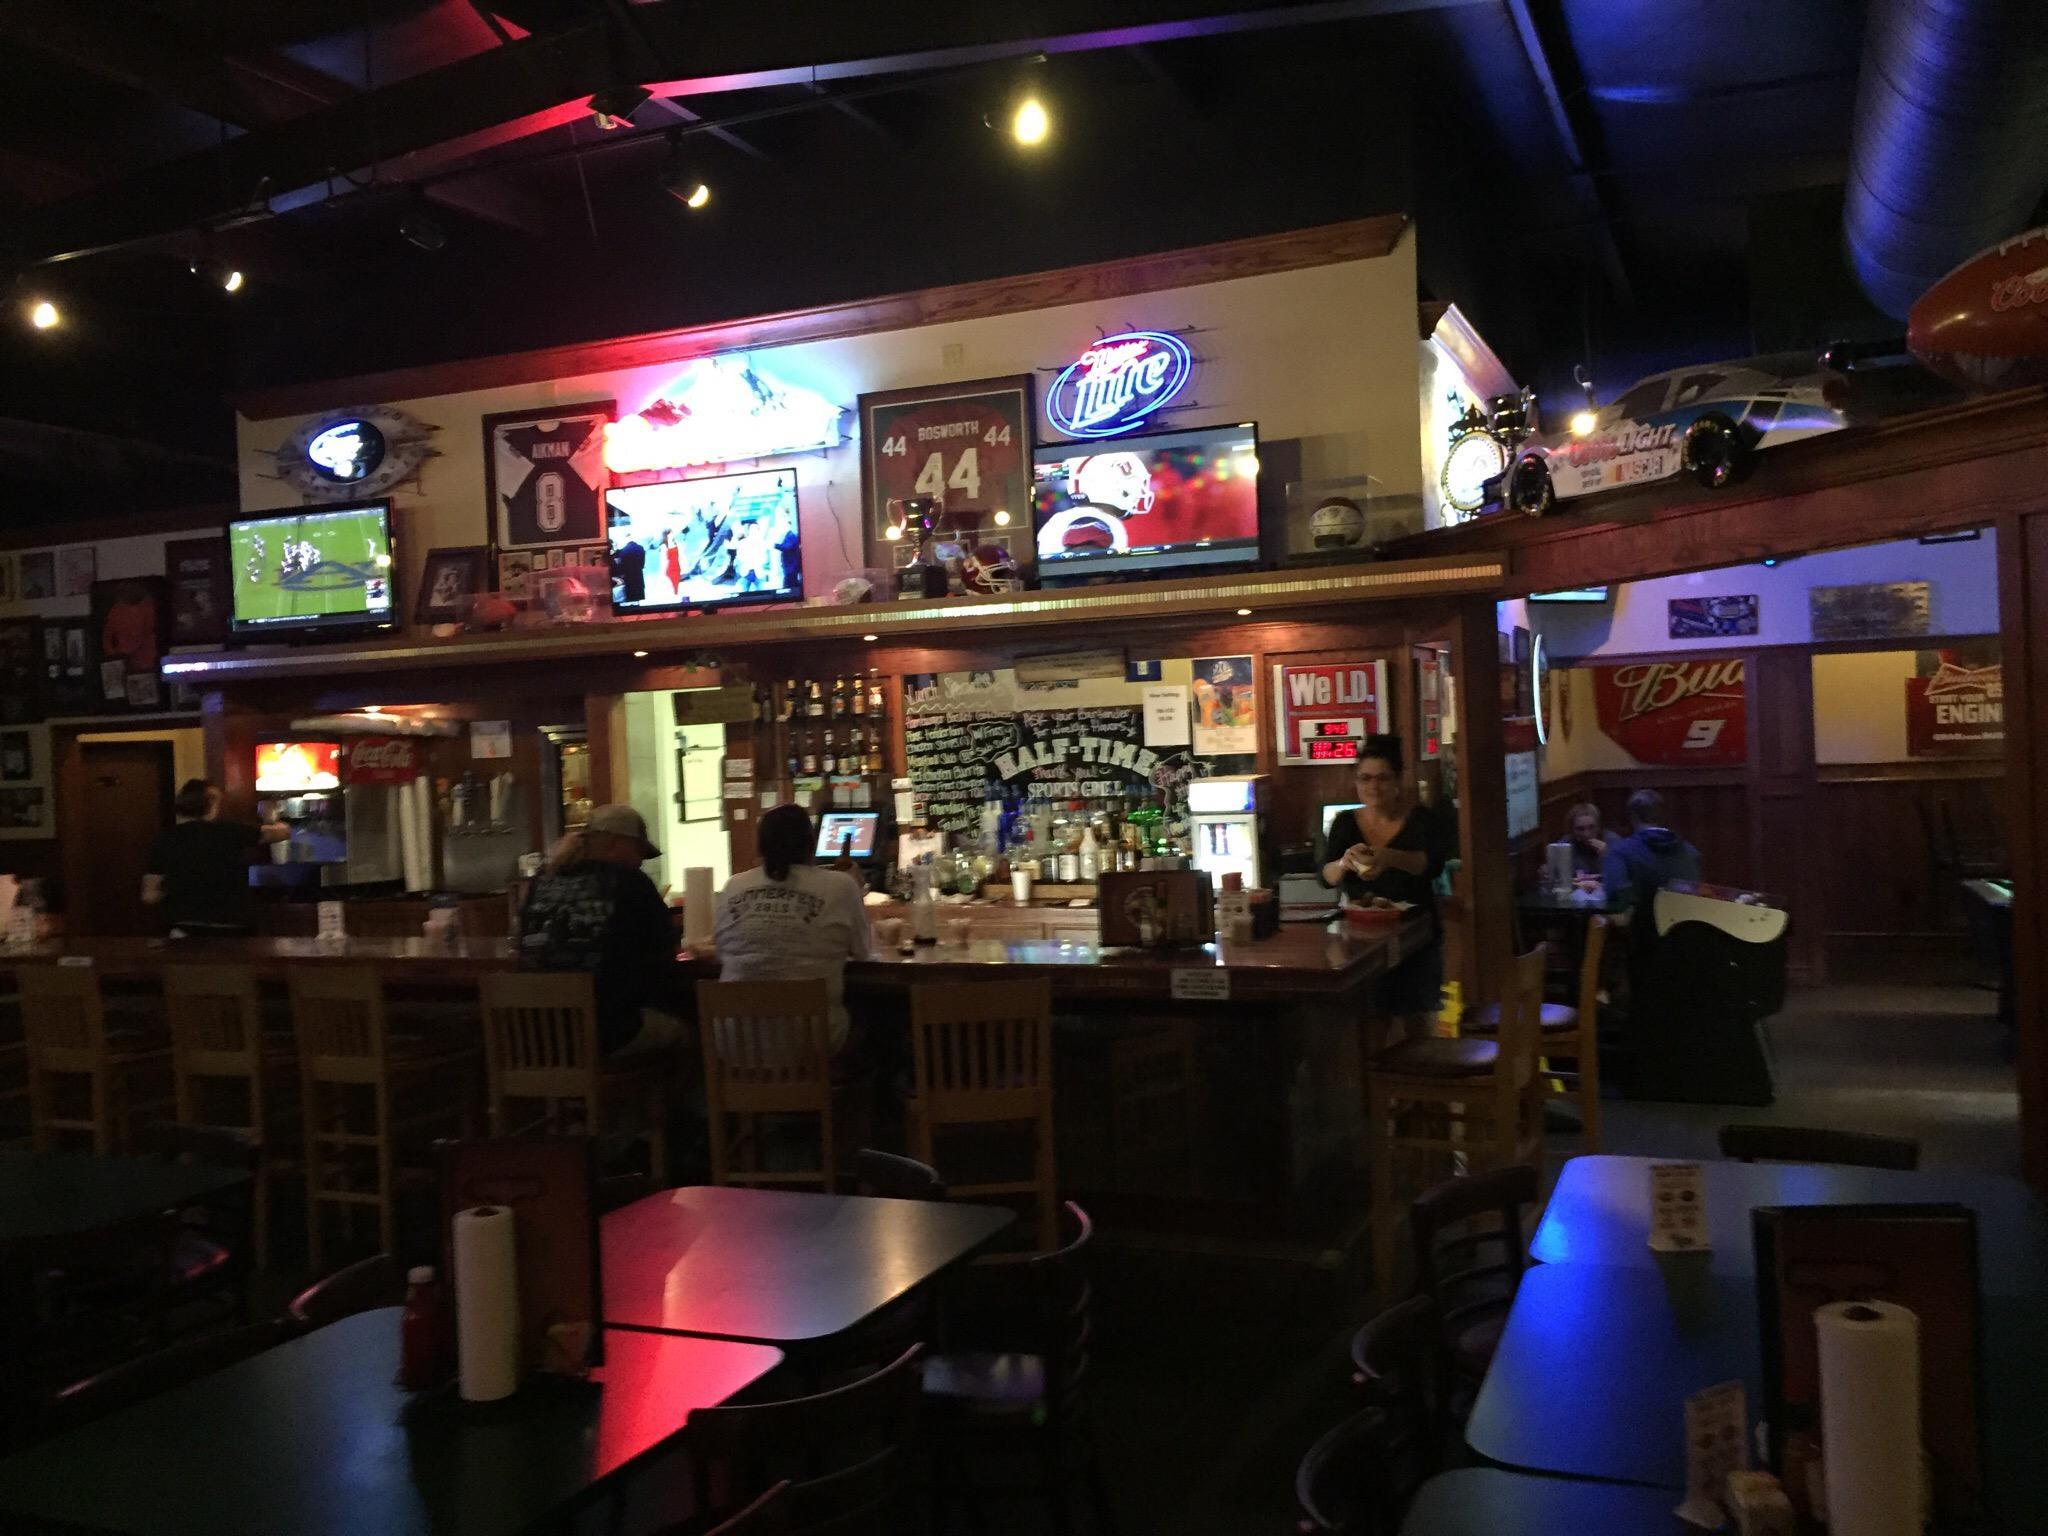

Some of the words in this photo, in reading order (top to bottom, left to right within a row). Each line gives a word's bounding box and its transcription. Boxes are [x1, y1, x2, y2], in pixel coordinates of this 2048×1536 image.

[917, 420, 980, 442] BOSWORTH
[984, 425, 1011, 448] 44
[1616, 423, 1676, 455] LIGHT
[531, 440, 571, 459] AIKMAN
[881, 436, 907, 457] 44
[914, 448, 982, 500] 44
[535, 471, 567, 533] 8
[1288, 672, 1332, 707] We
[1336, 669, 1375, 704] I.D.
[1681, 719, 1728, 749] 9
[994, 737, 1159, 780] HALF-TIME
[1027, 781, 1079, 799] SPORTS
[1080, 780, 1125, 797] GRILL
